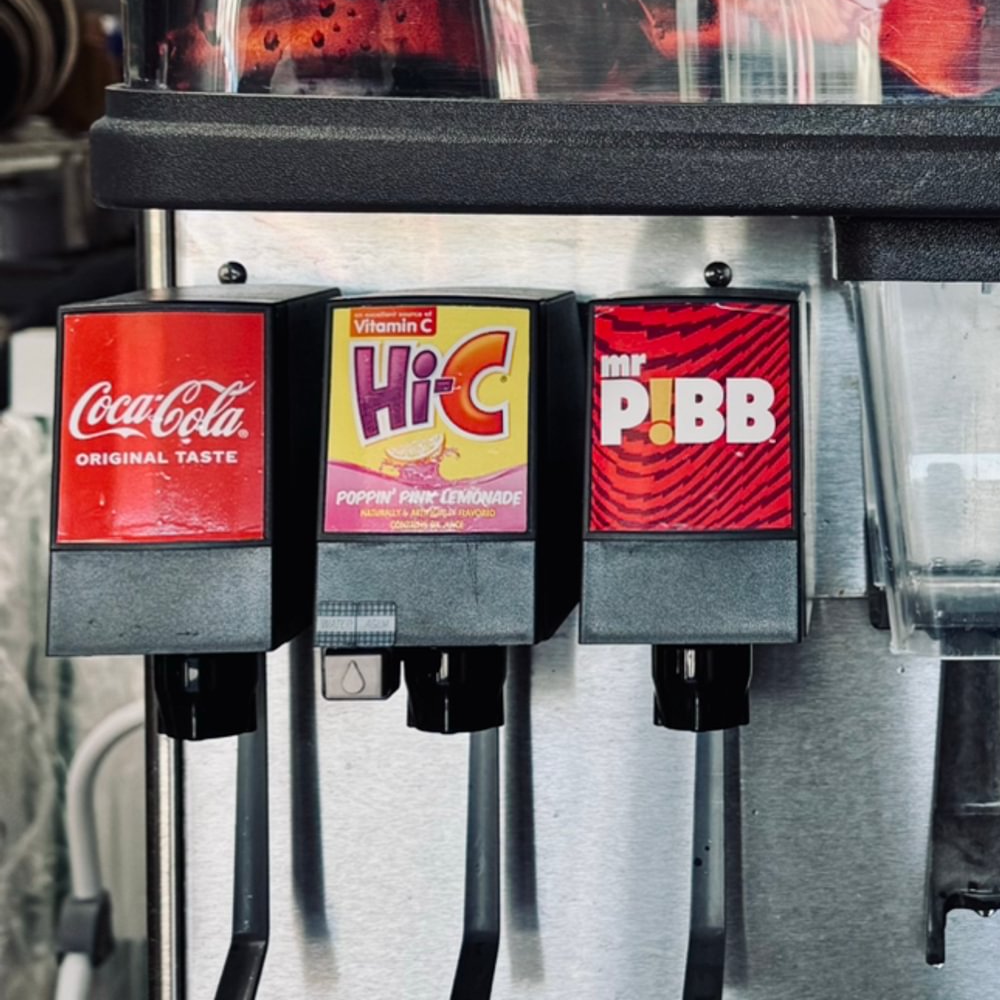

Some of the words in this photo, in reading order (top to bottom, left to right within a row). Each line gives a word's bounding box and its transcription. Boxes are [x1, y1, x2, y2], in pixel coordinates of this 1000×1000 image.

[353, 318, 418, 335] Vitamin
[420, 318, 433, 334] C
[601, 353, 646, 377] mr
[352, 328, 513, 443] Hi-C
[69, 379, 256, 441] Coca-Cola
[75, 452, 169, 467] ORIGINAL
[175, 450, 238, 465] TASTE
[336, 487, 396, 506] POPPIN'
[440, 487, 523, 507] LEMONADE
